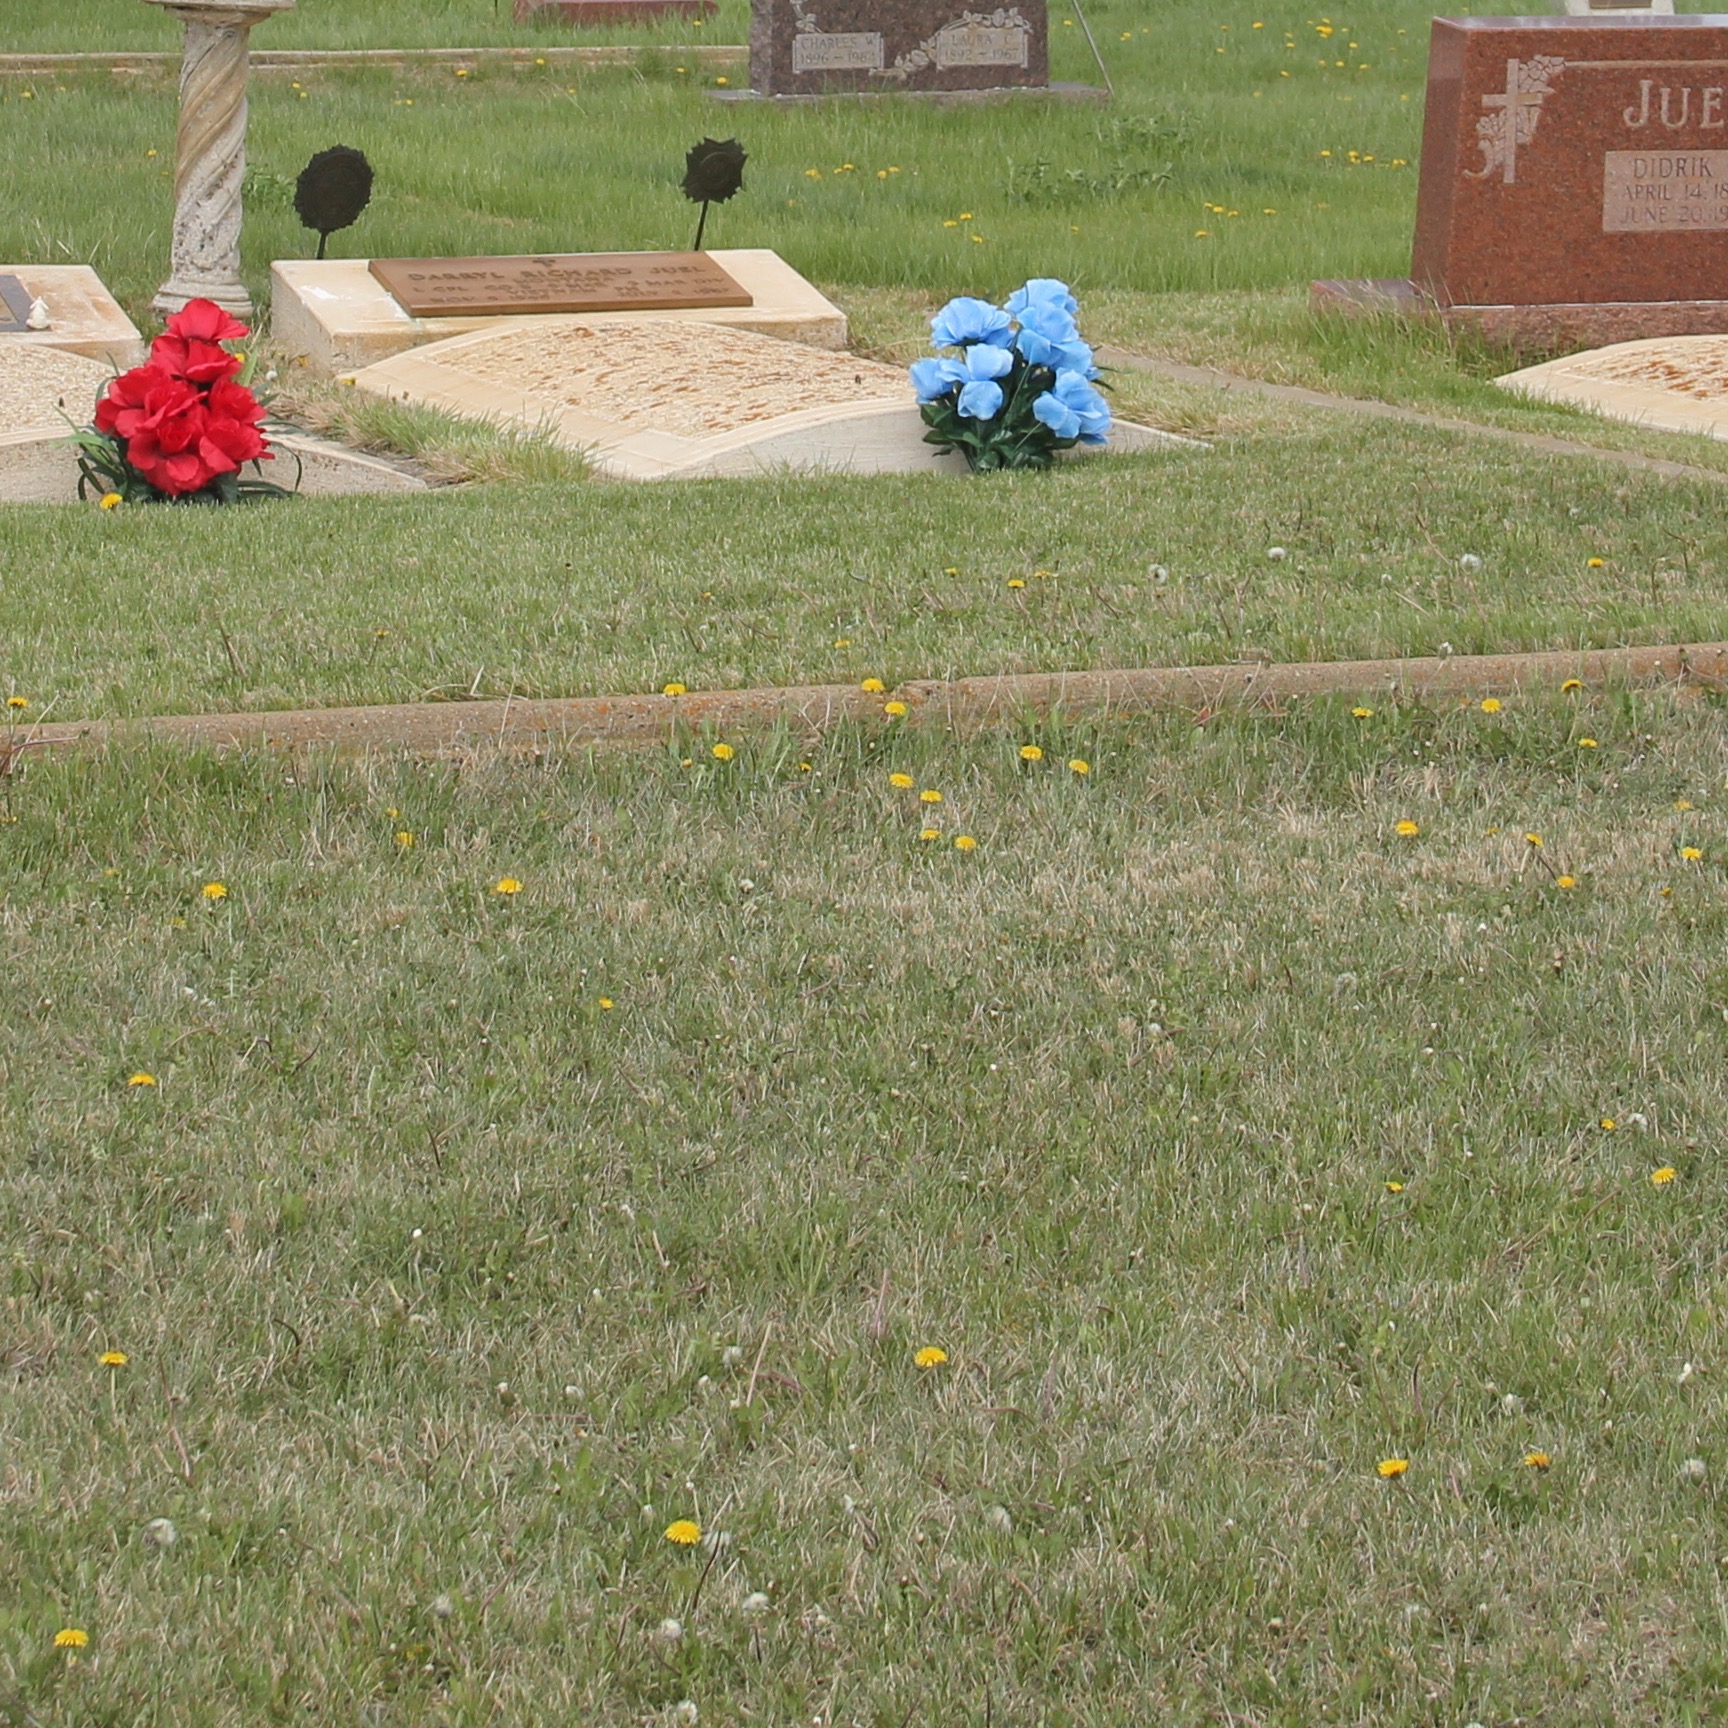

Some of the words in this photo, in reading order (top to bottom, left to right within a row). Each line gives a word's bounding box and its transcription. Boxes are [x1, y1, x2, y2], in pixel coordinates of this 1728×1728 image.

[800, 37, 857, 50] CHARLES
[951, 34, 993, 46] LAURA
[1633, 157, 1712, 179] DIDRIK
[1622, 184, 1672, 201] APRIL
[1620, 206, 1668, 224] JUNE
[408, 271, 505, 282] DARRYL
[521, 268, 633, 278] RICHARD
[649, 266, 707, 274] JUEL
